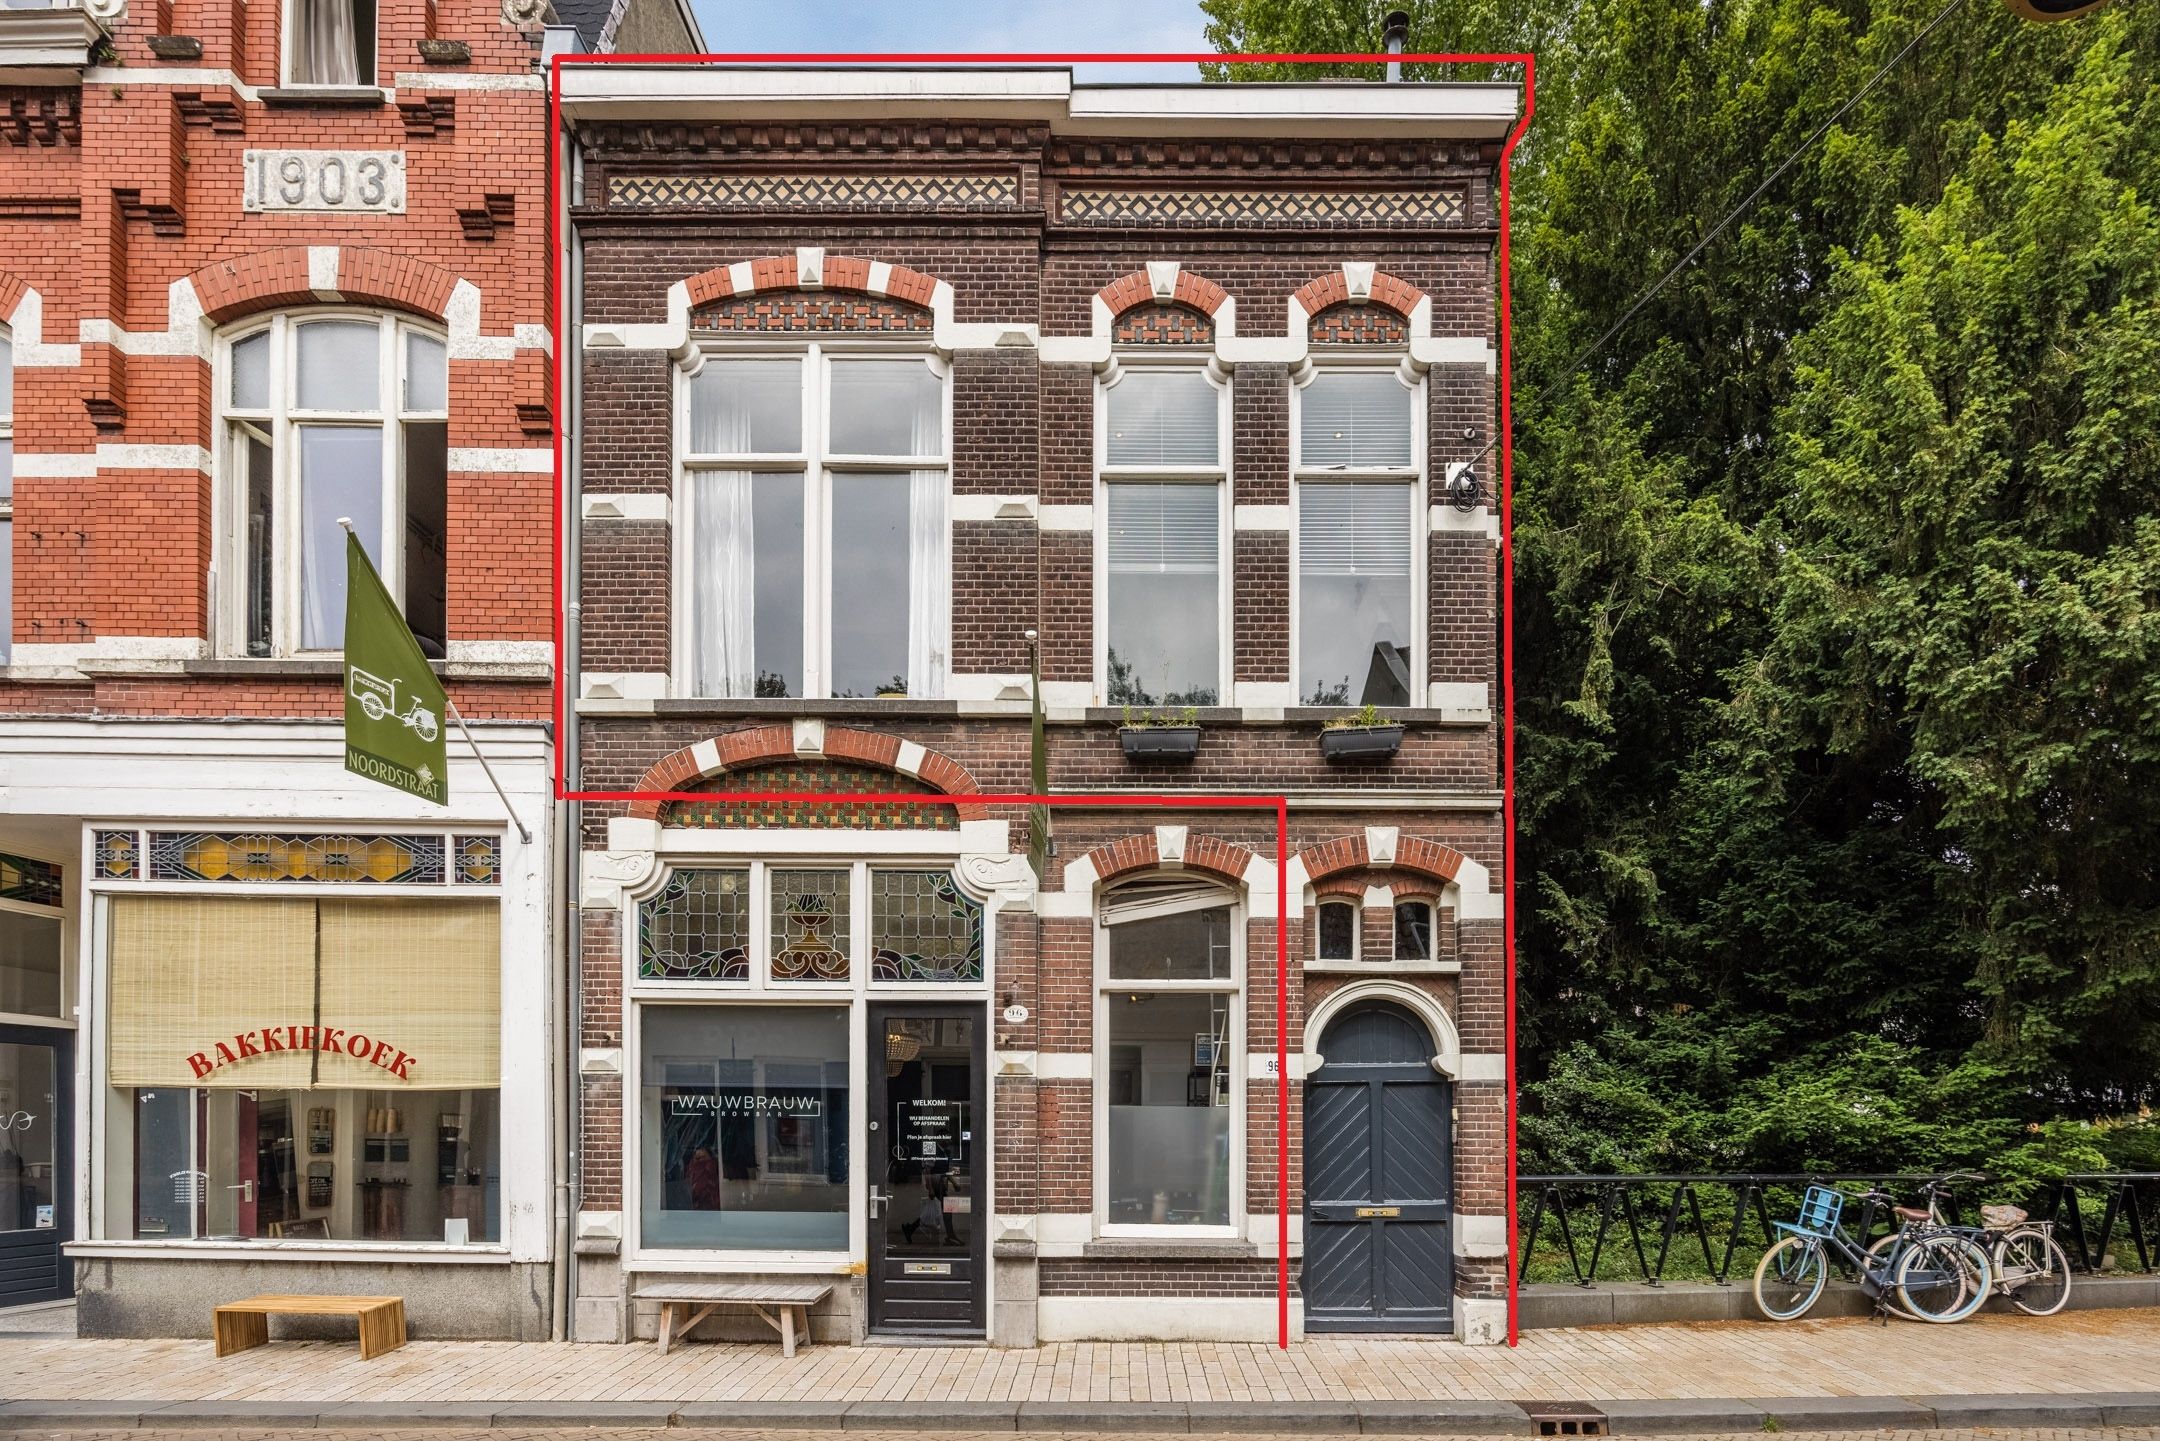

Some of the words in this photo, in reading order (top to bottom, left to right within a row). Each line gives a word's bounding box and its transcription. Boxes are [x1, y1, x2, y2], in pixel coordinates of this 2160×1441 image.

[258, 156, 386, 205] 1903
[348, 750, 439, 799] NOORDSTRAAT
[186, 1025, 417, 1081] BAKKIEKOEK
[677, 1095, 815, 1110] WAUWBRAUW
